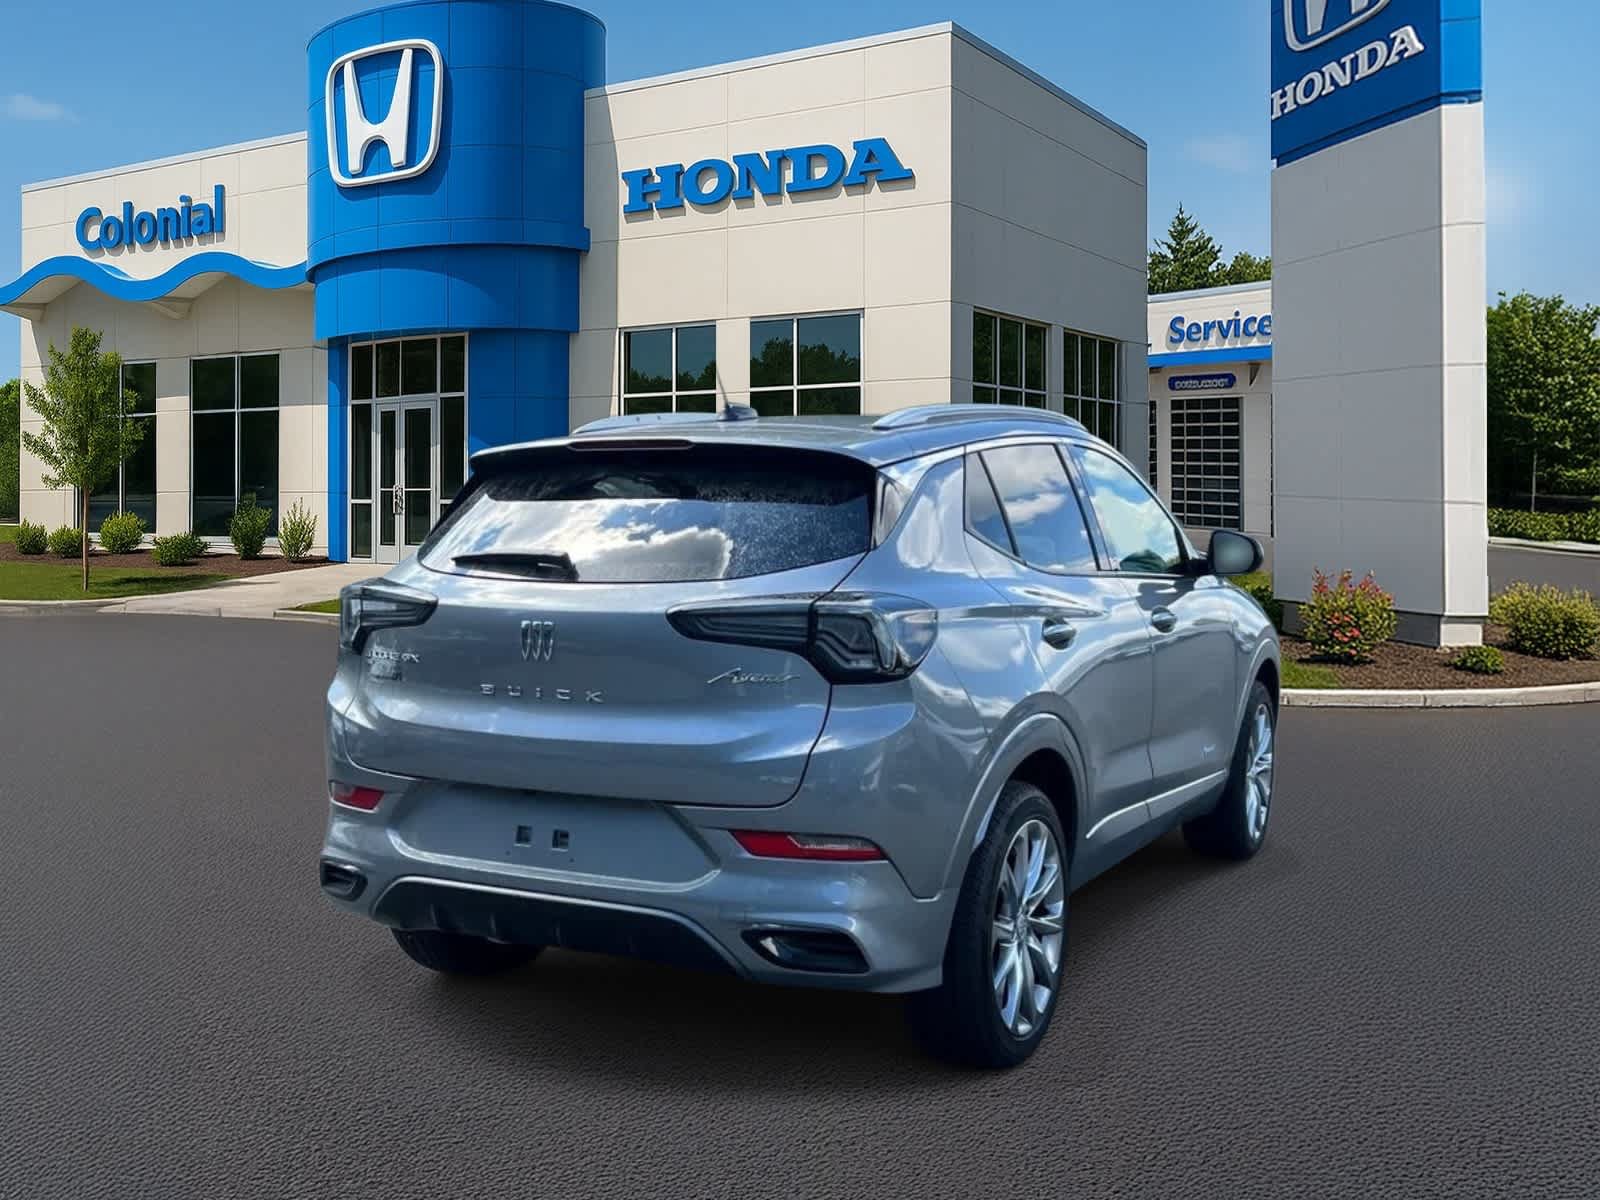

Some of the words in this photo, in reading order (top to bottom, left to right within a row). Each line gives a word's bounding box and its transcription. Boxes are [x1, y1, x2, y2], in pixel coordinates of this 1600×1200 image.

[1271, 25, 1424, 120] HONDA
[622, 137, 913, 214] HONDA
[76, 184, 225, 251] Colonial
[1169, 309, 1272, 344] Service
[480, 683, 604, 703] BUICK
